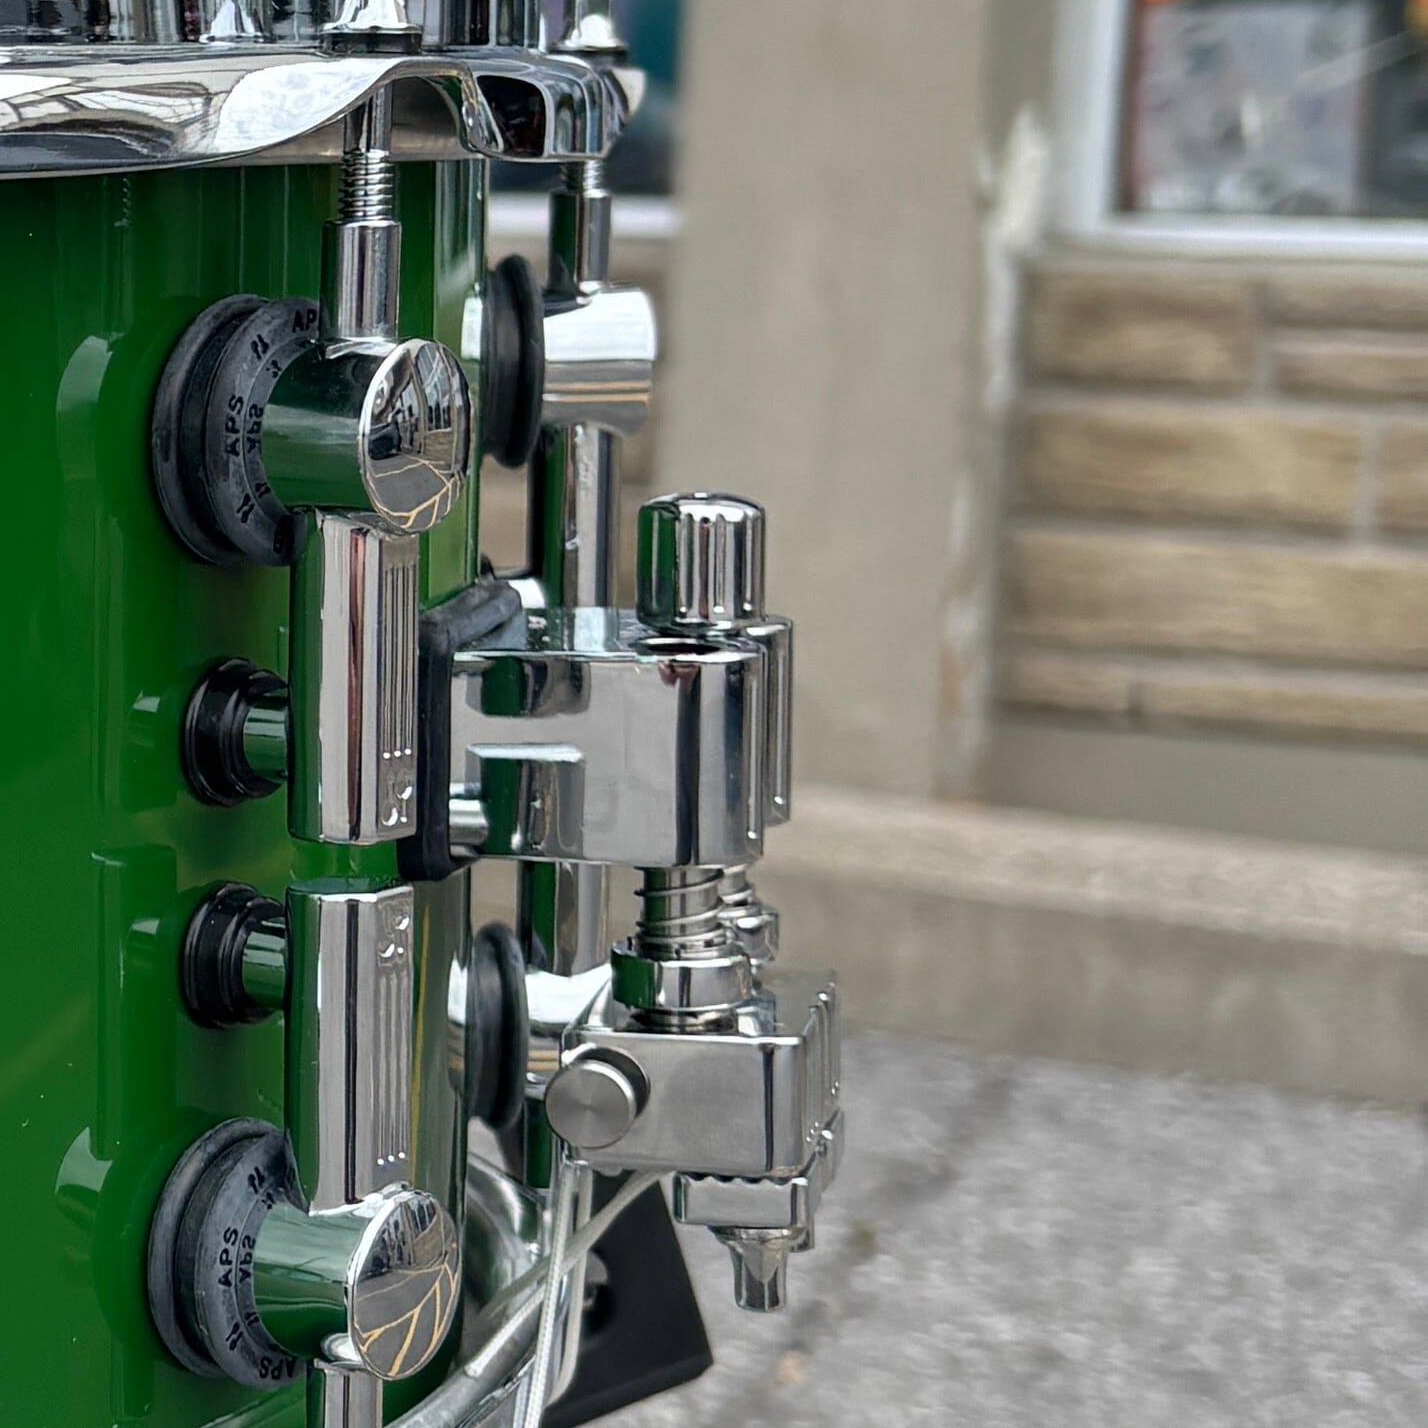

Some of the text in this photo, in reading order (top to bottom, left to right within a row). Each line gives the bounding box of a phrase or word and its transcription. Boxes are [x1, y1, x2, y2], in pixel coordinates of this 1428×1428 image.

[293, 308, 317, 333] AP
[225, 394, 244, 457] APS
[218, 1226, 239, 1288] APS
